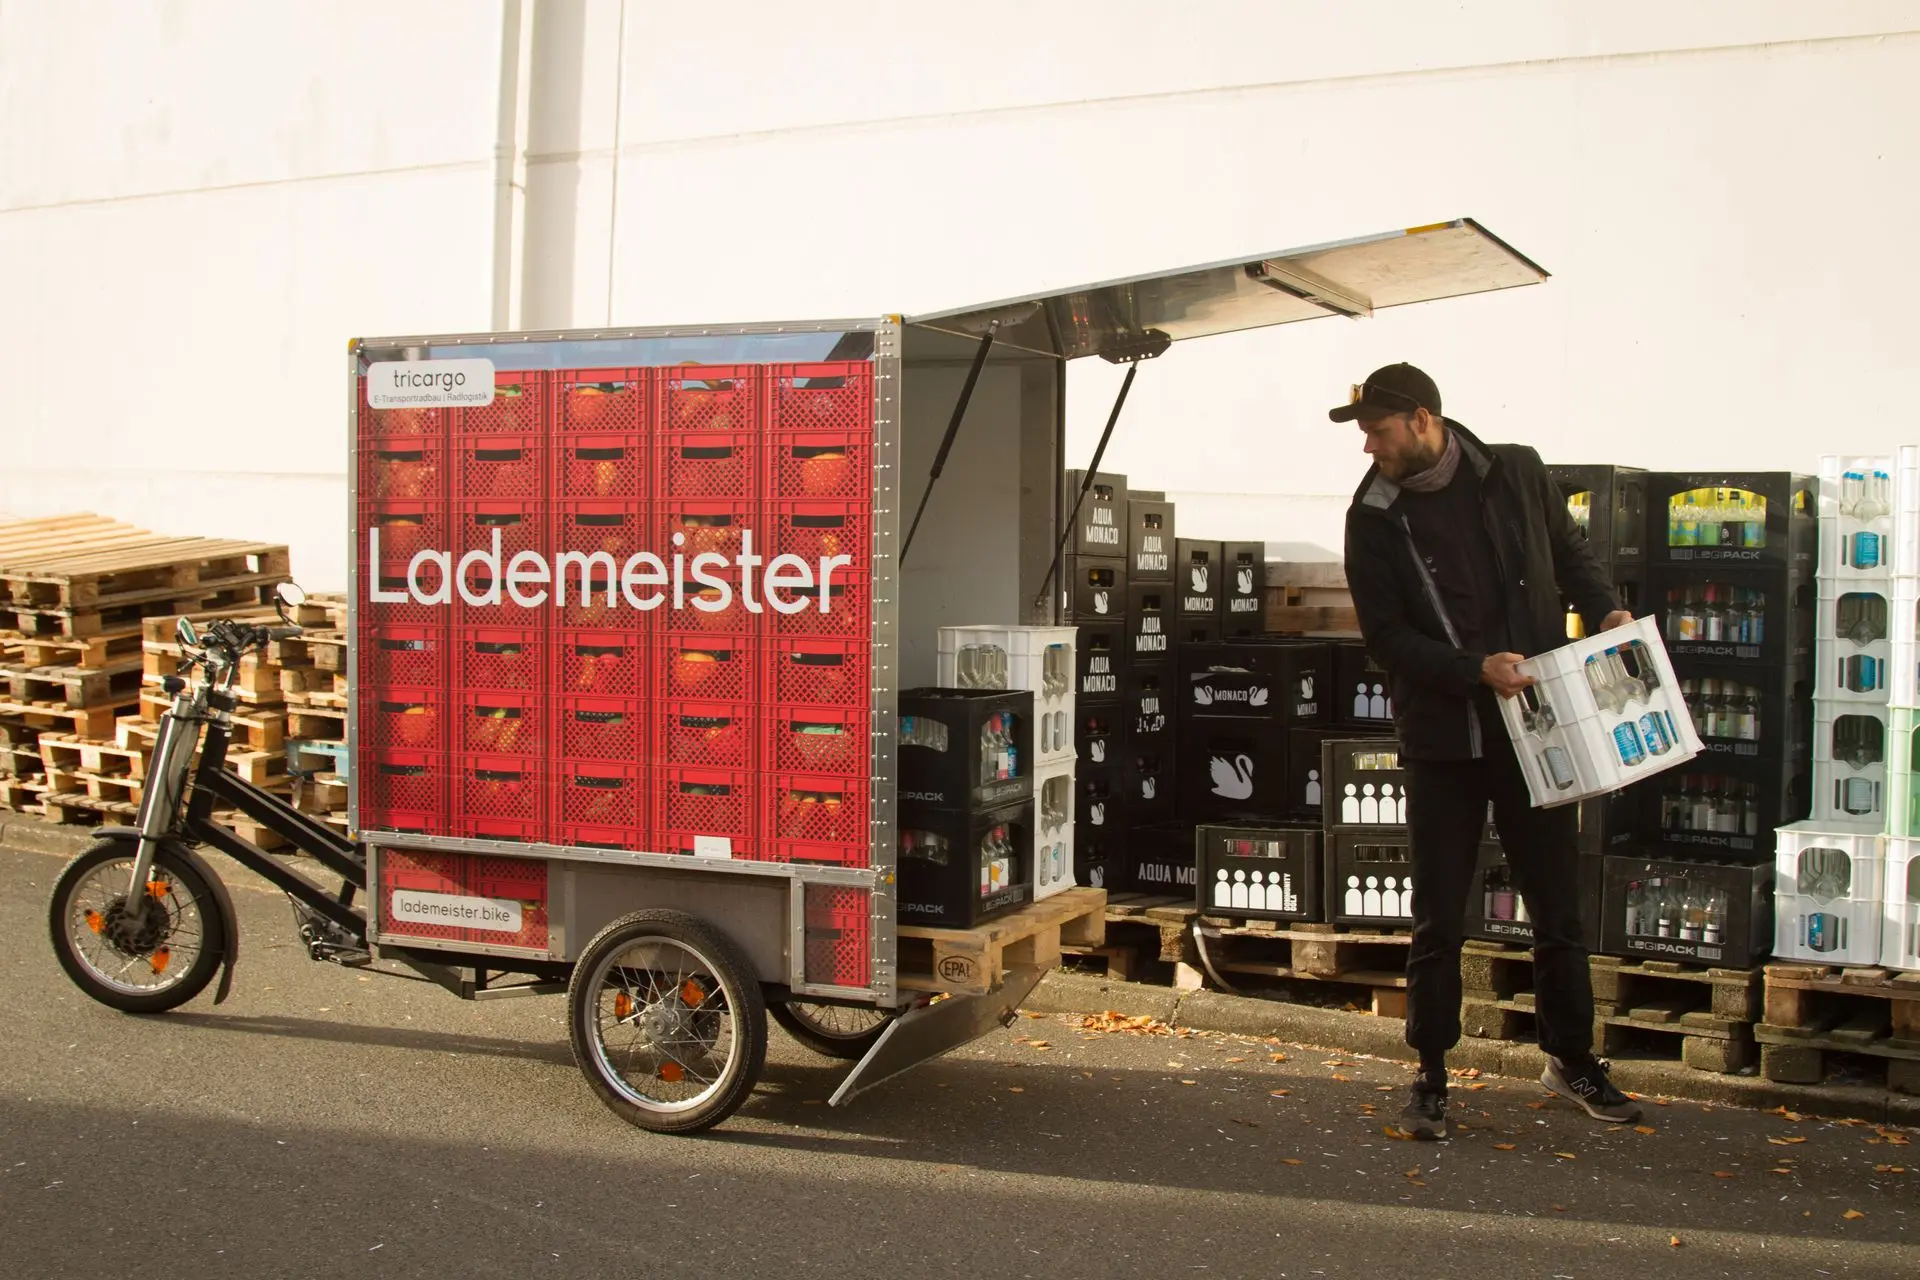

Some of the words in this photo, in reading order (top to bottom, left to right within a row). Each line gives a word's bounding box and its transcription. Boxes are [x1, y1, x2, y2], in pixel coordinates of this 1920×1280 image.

[394, 369, 466, 392] tricargo
[373, 392, 441, 403] E-Transportradbau
[447, 390, 488, 402] Radlogistik
[1092, 507, 1113, 525] AQUA
[1086, 525, 1119, 544] MONACO
[1143, 536, 1162, 552] AQUA
[1137, 553, 1168, 571] MONACO
[369, 527, 851, 614] Lademeister
[1184, 596, 1214, 612] MONACO
[1231, 598, 1258, 613] MONACO
[1142, 617, 1161, 633] AQUA
[1136, 635, 1167, 651] MONACO
[1089, 657, 1110, 673] AQUA
[1083, 675, 1116, 692] MONACO
[1214, 690, 1248, 701] MONACO
[1297, 702, 1317, 716] MONACO
[1138, 862, 1172, 883] AQUA
[400, 899, 510, 922] lademeister.bike
[1290, 894, 1298, 912] COLA
